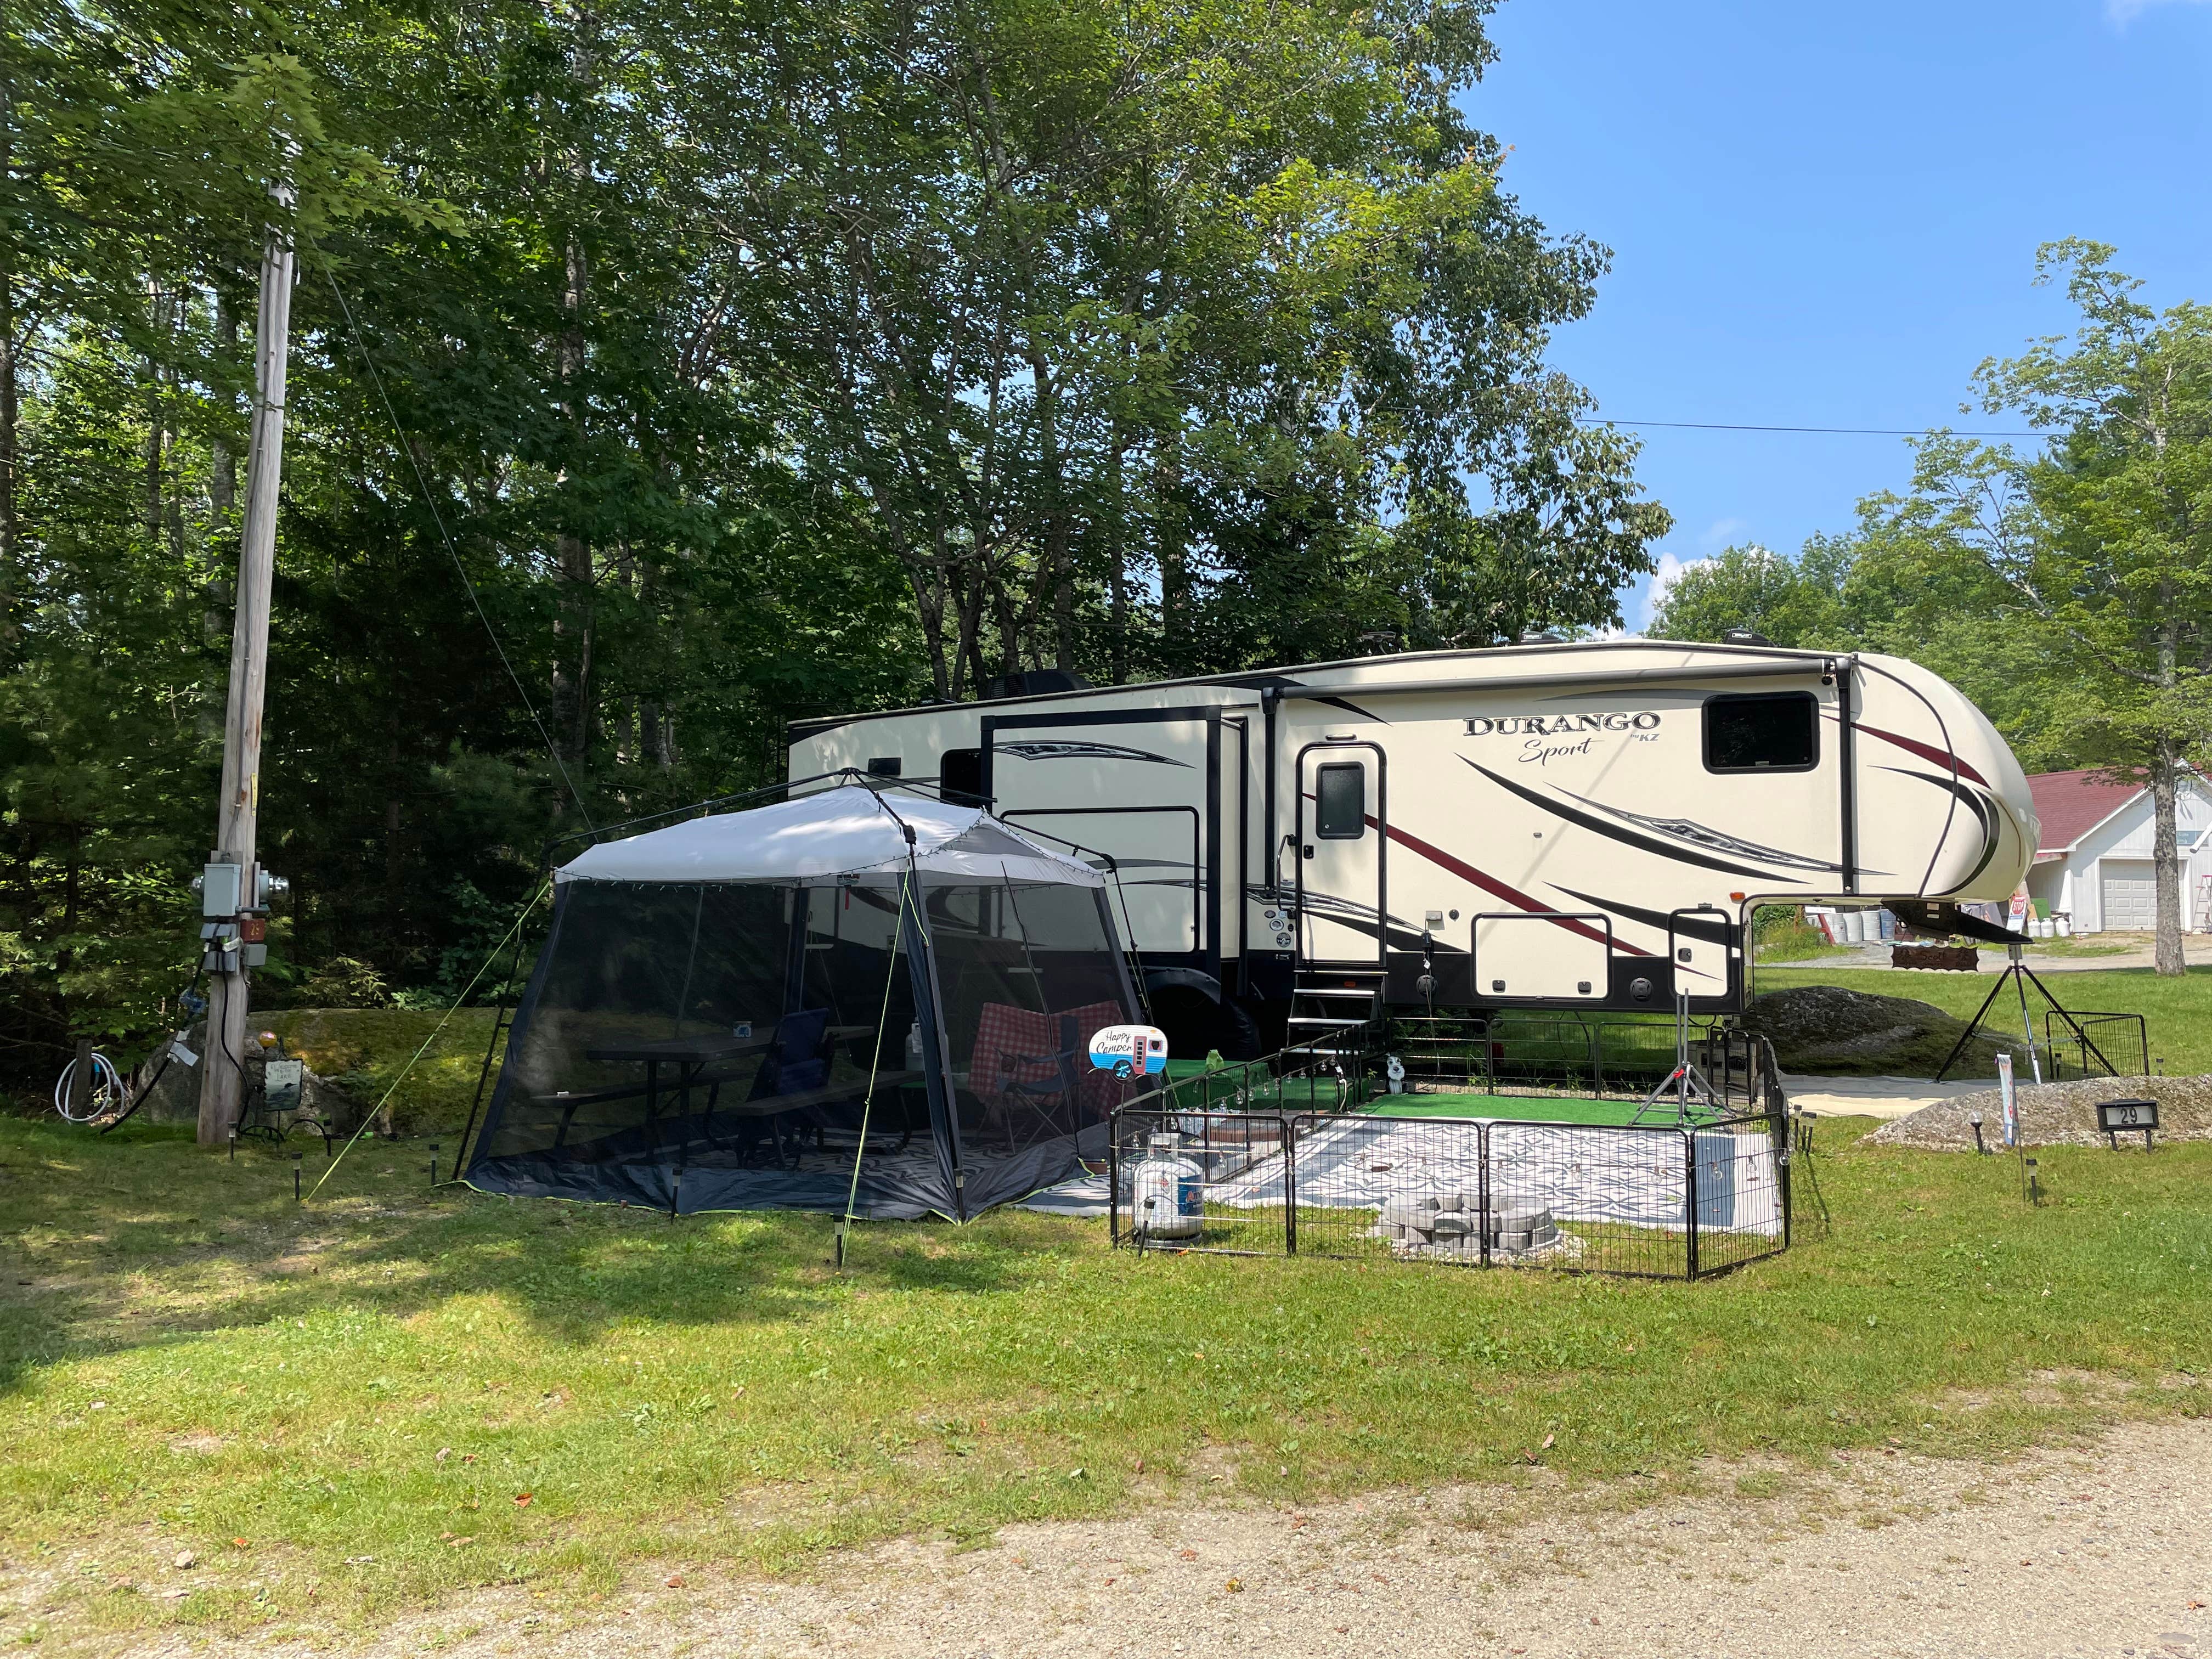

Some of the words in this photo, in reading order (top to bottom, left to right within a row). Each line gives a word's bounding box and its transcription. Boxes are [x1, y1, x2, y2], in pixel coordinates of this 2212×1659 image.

[1463, 712, 1661, 736] DURANGO
[1639, 733, 1660, 742] KZ
[1518, 737, 1605, 766] Sport
[2012, 901, 2024, 911] STOP
[1105, 1031, 1132, 1043] Happy
[1096, 1042, 1133, 1057] Camper
[2120, 1107, 2137, 1124] 29
